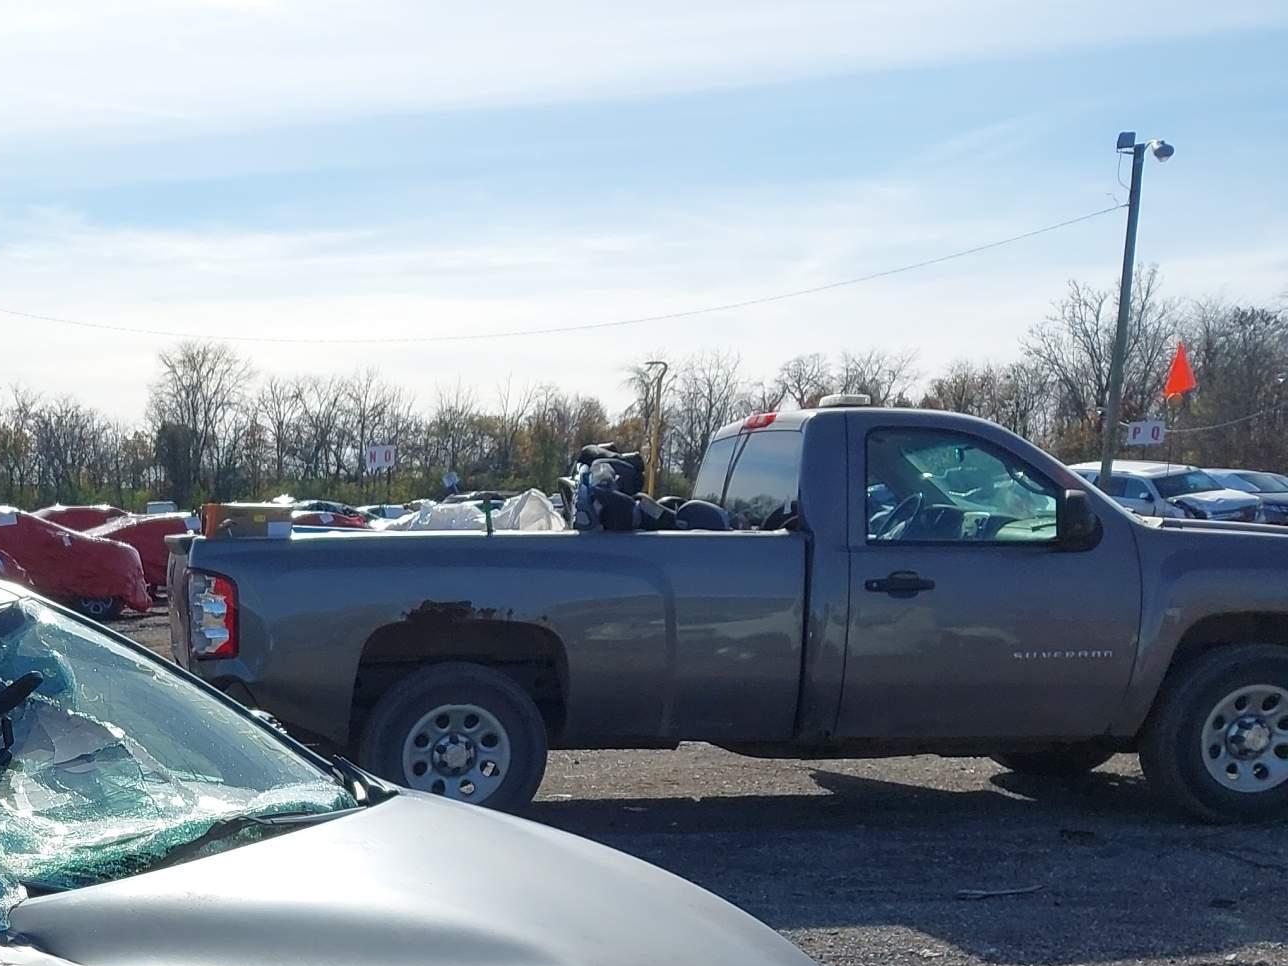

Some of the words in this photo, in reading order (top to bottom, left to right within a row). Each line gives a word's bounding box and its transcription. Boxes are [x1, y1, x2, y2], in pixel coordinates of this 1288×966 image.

[1133, 426, 1141, 440] P
[369, 451, 376, 463] N
[1013, 650, 1113, 659] SILVERADO
